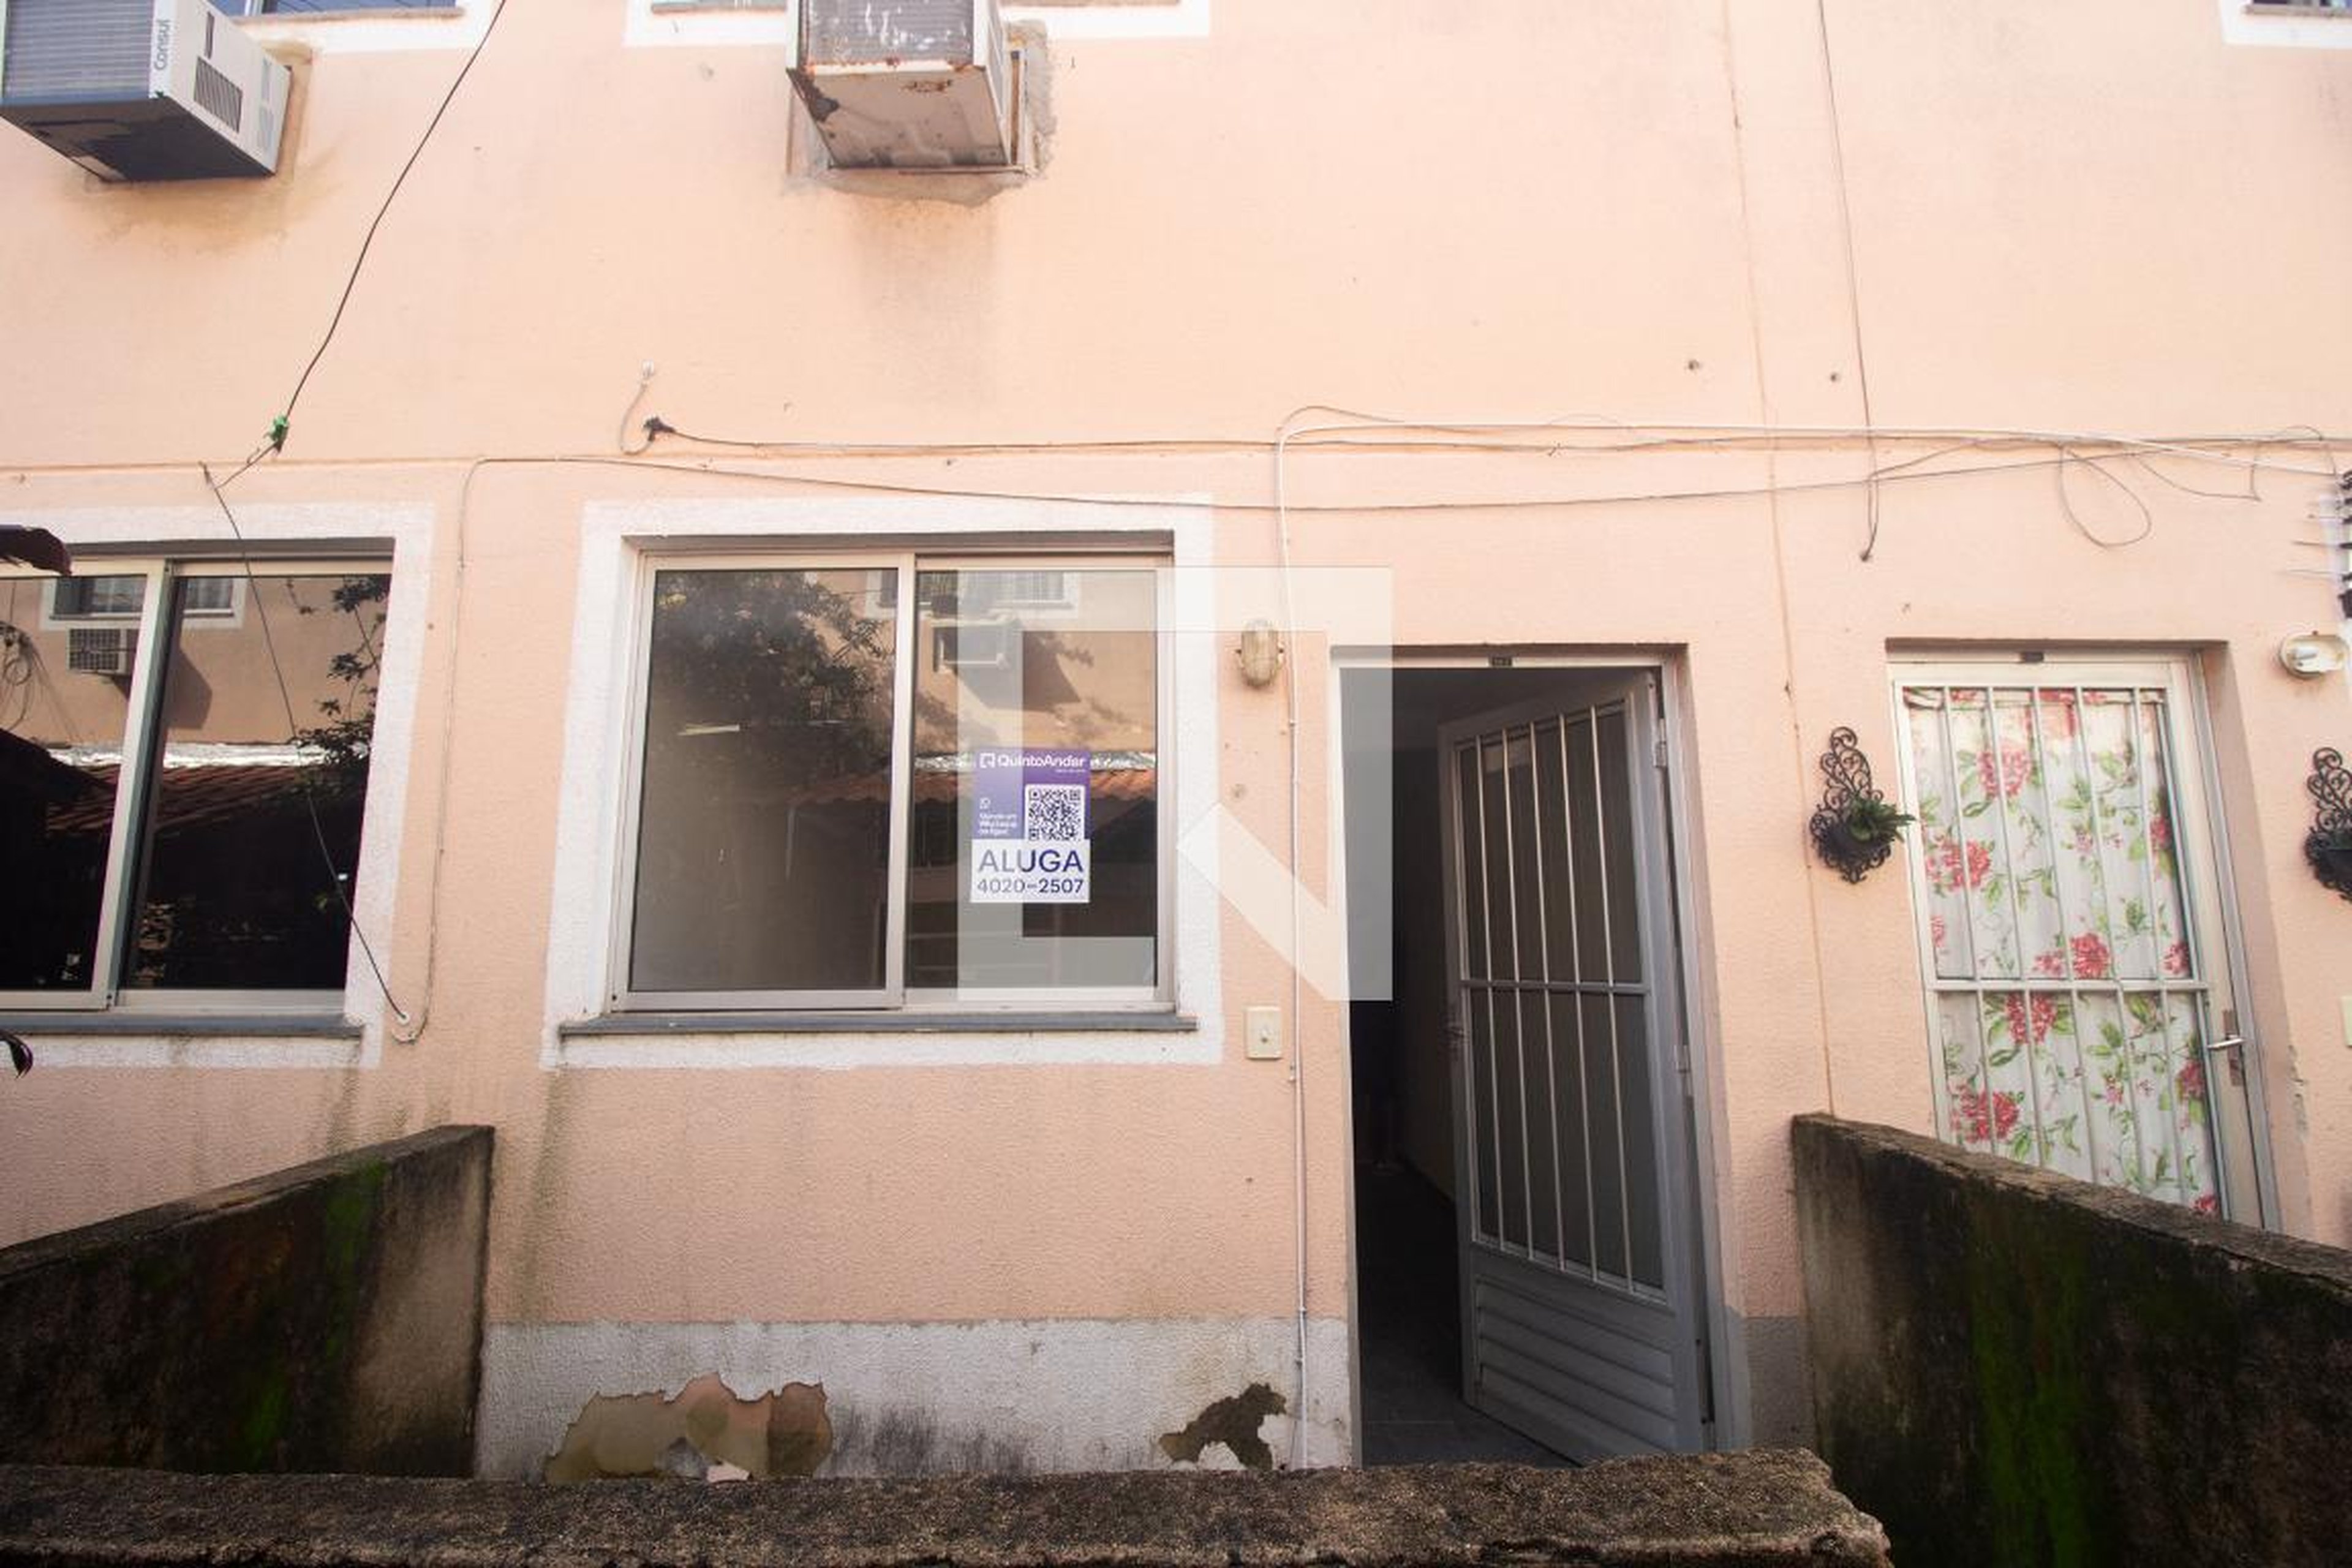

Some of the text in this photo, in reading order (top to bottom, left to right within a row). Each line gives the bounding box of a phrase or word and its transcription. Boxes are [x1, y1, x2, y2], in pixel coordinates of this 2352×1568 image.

[154, 19, 170, 70] Consul
[979, 850, 1084, 872] ALUGA
[978, 878, 1084, 893] 4020-2507
